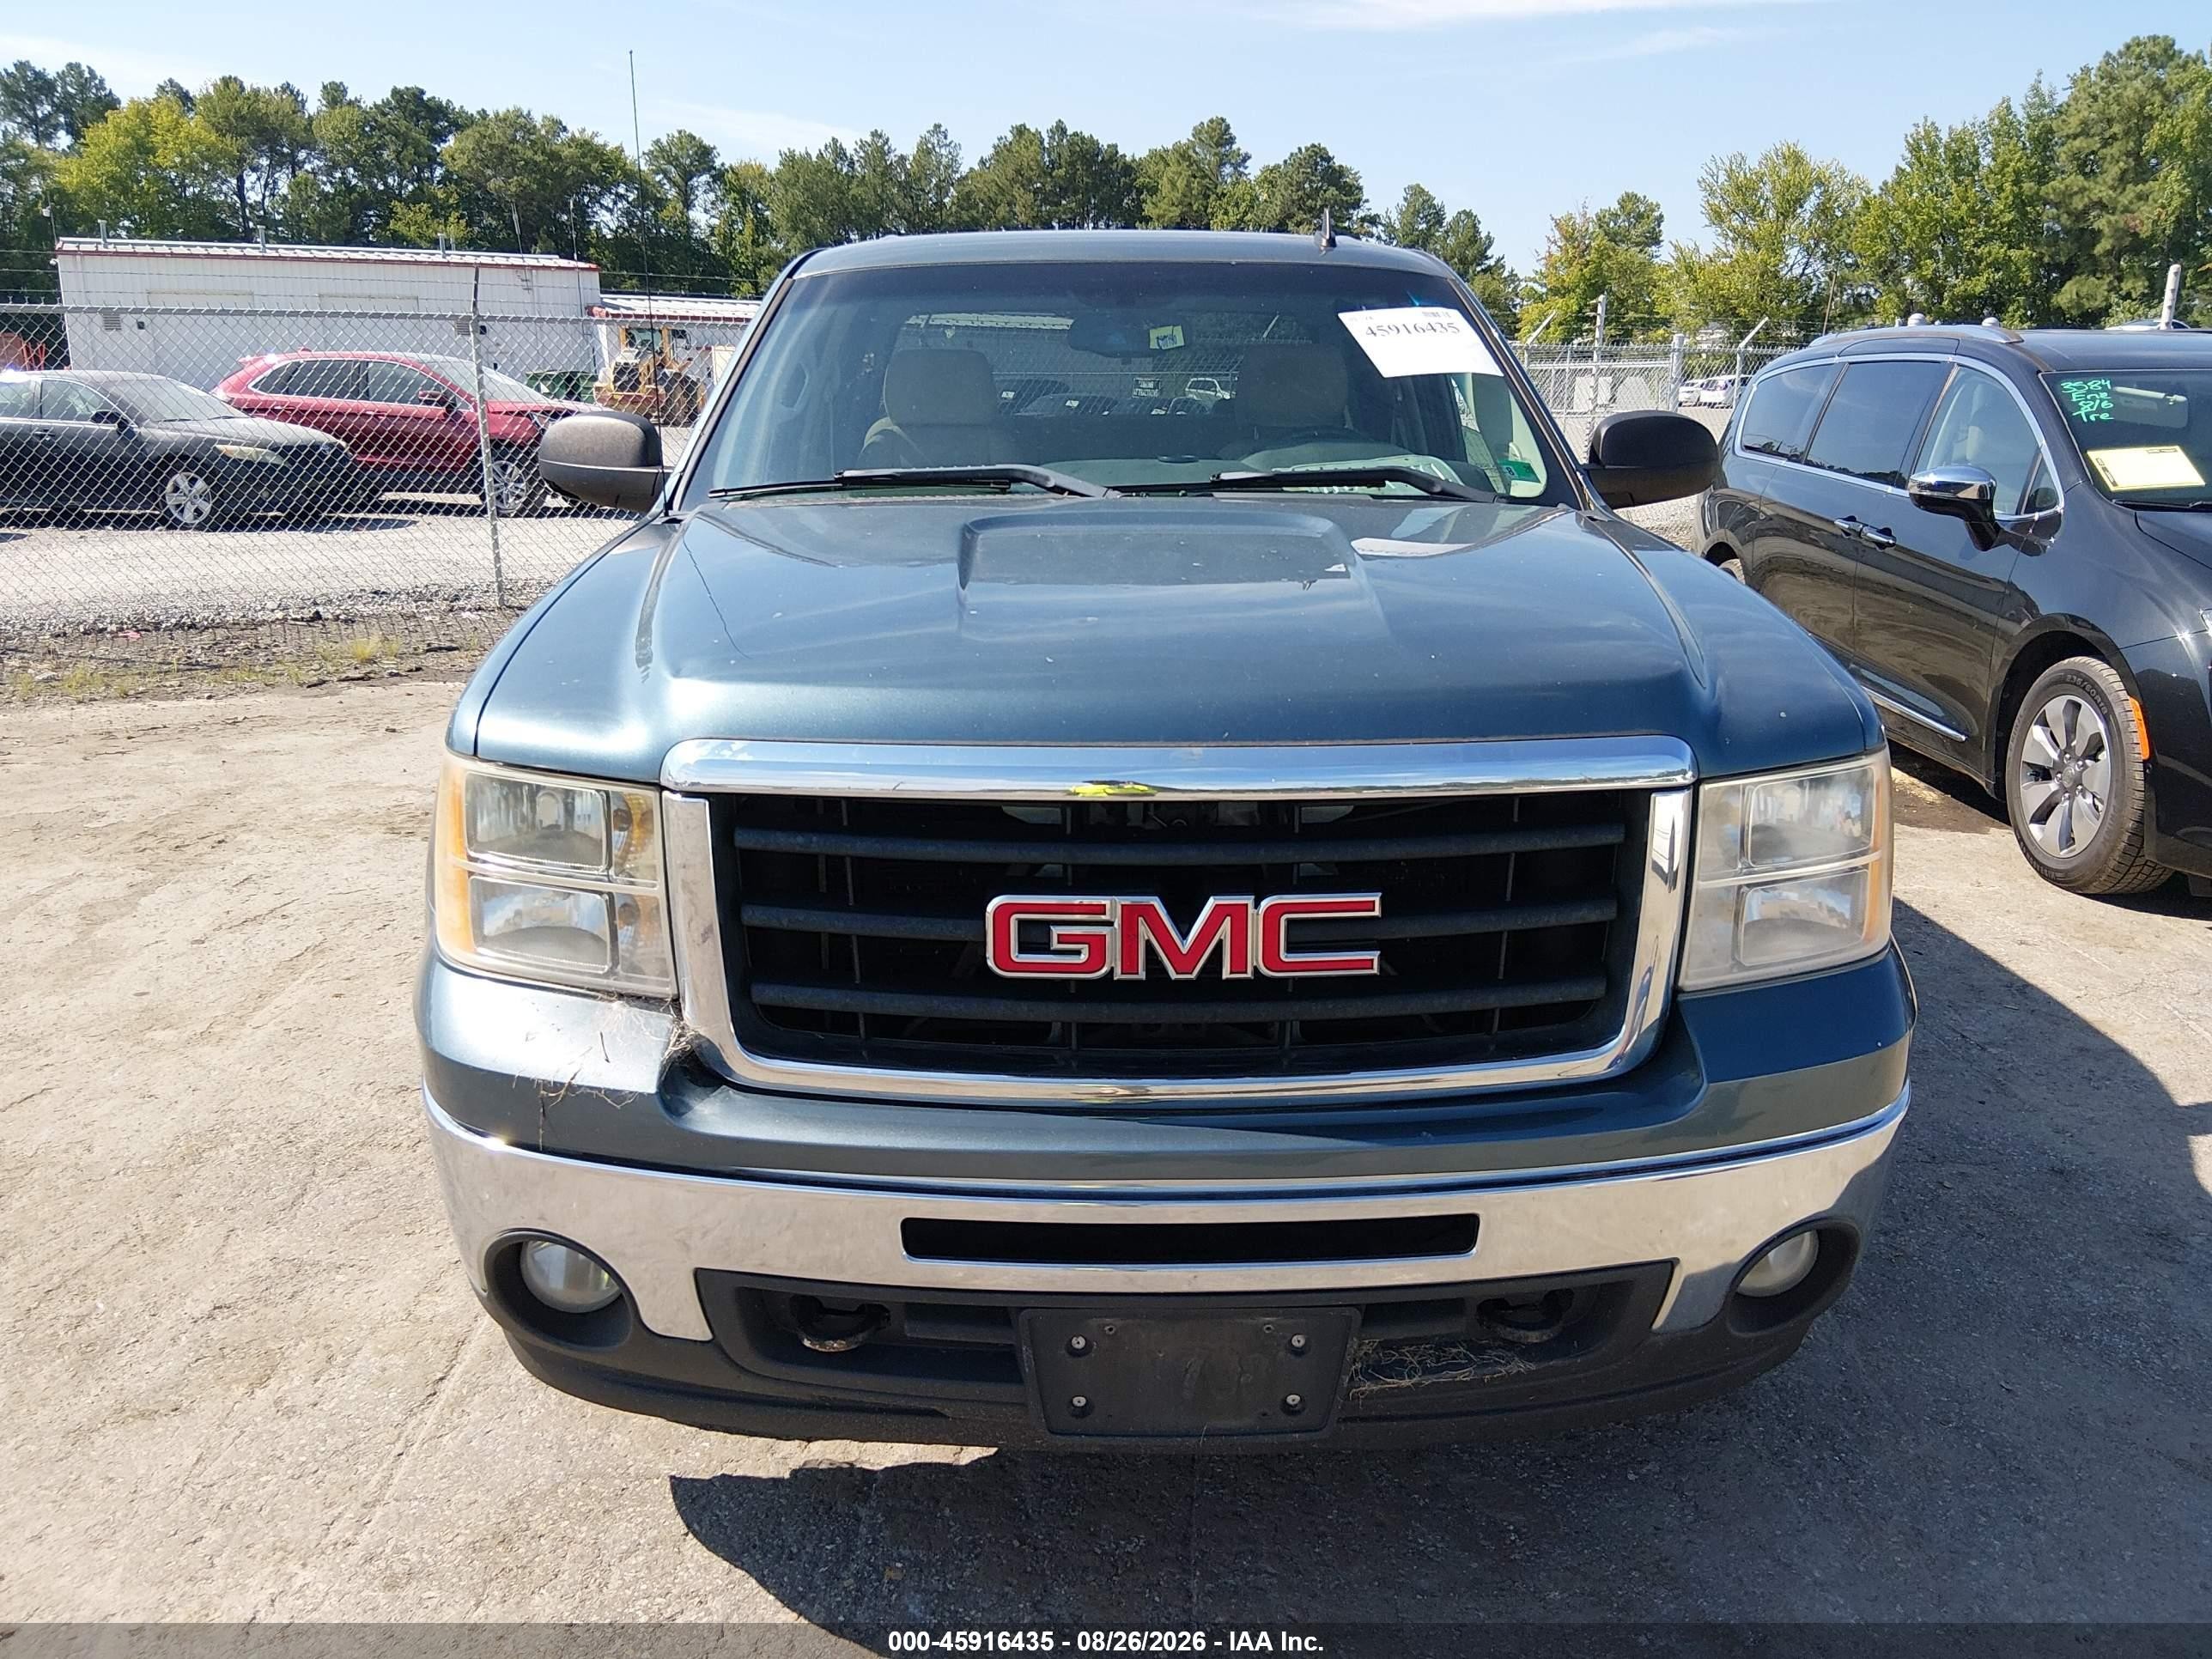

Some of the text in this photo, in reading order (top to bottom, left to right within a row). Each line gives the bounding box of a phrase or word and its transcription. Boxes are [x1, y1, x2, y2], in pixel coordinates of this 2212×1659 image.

[1365, 321, 1461, 337] 45916435
[2060, 379, 2112, 392] 3584
[986, 892, 1382, 981] GMC
